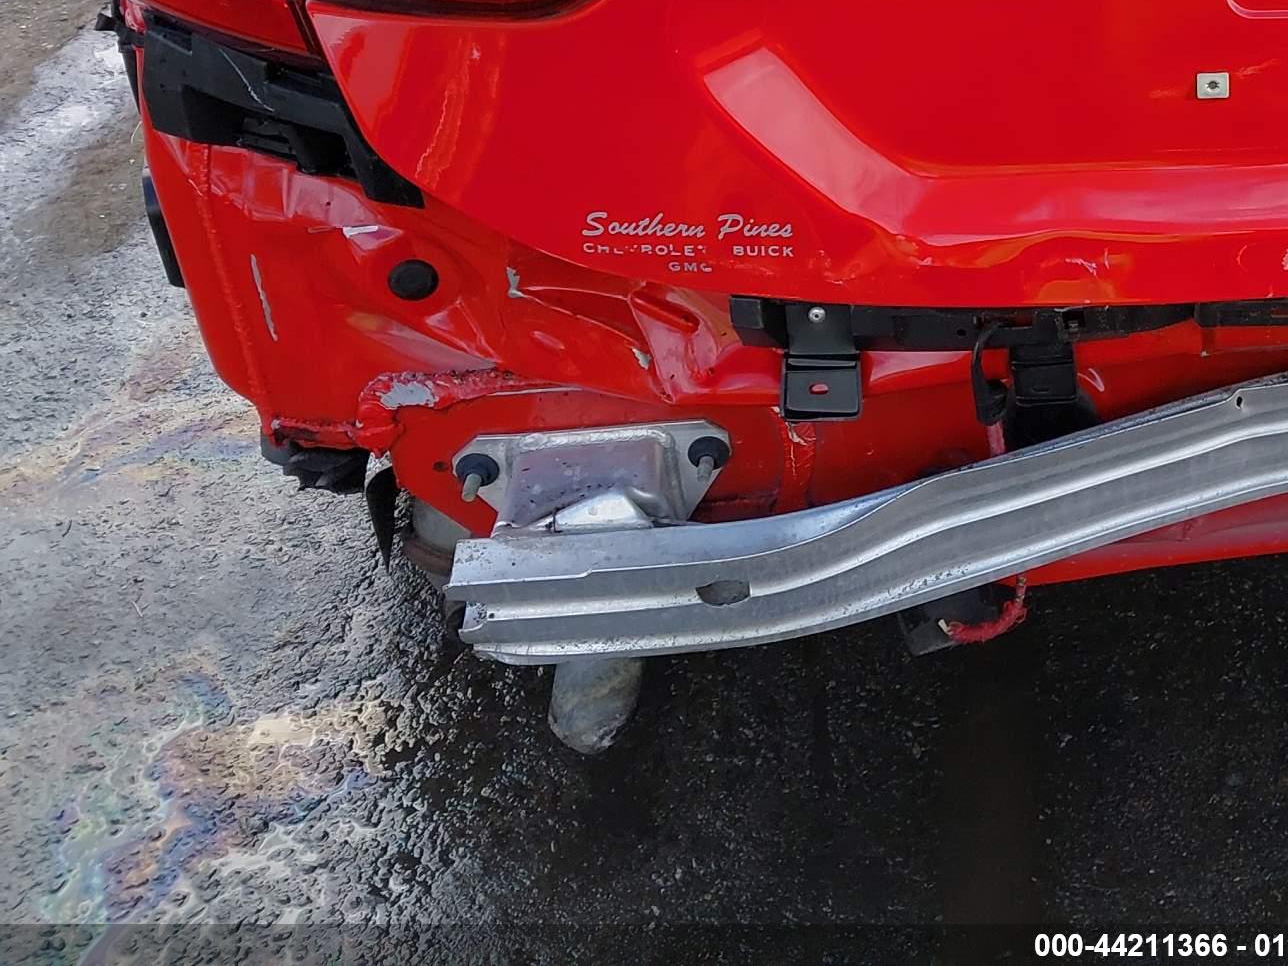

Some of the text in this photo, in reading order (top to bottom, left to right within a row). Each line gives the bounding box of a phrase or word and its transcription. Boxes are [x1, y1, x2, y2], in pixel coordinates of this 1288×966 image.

[581, 211, 793, 240] Southern Pines
[732, 245, 794, 257] BUICK
